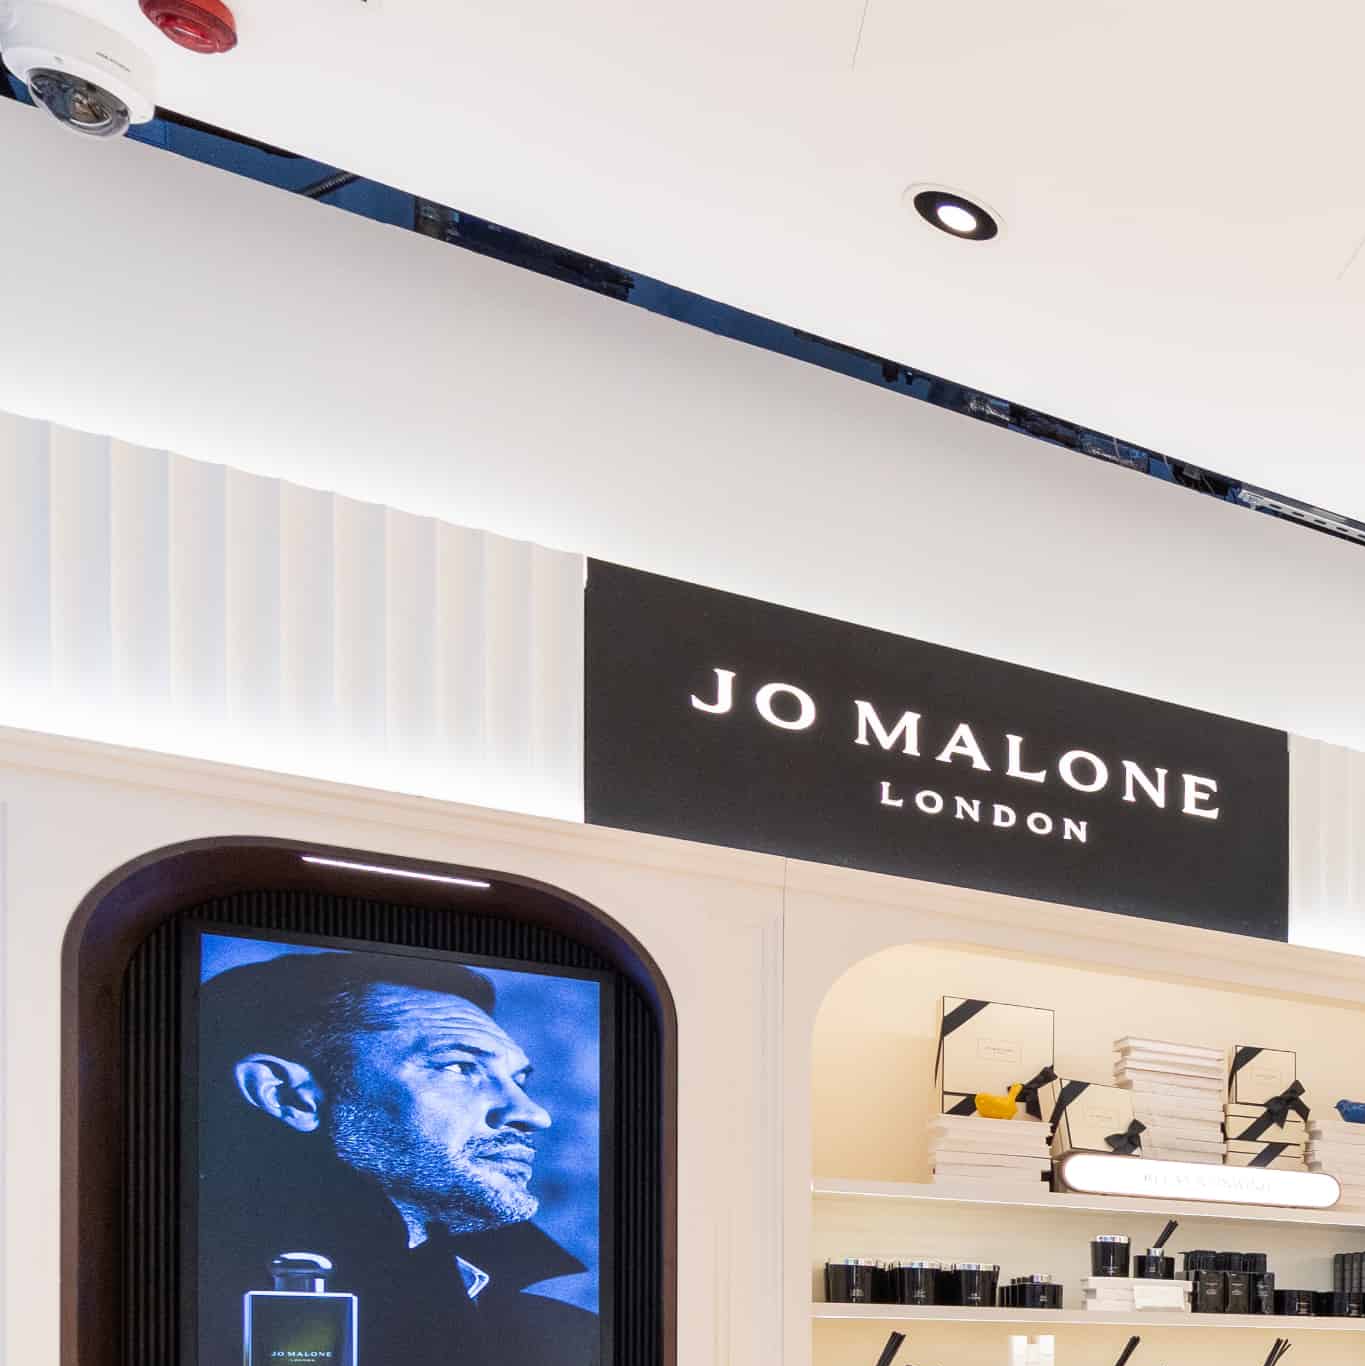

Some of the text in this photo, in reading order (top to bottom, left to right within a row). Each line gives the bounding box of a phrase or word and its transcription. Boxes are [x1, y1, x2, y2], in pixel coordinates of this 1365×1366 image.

[690, 668, 1220, 820] JO MALONE
[880, 781, 1088, 843] LONDON
